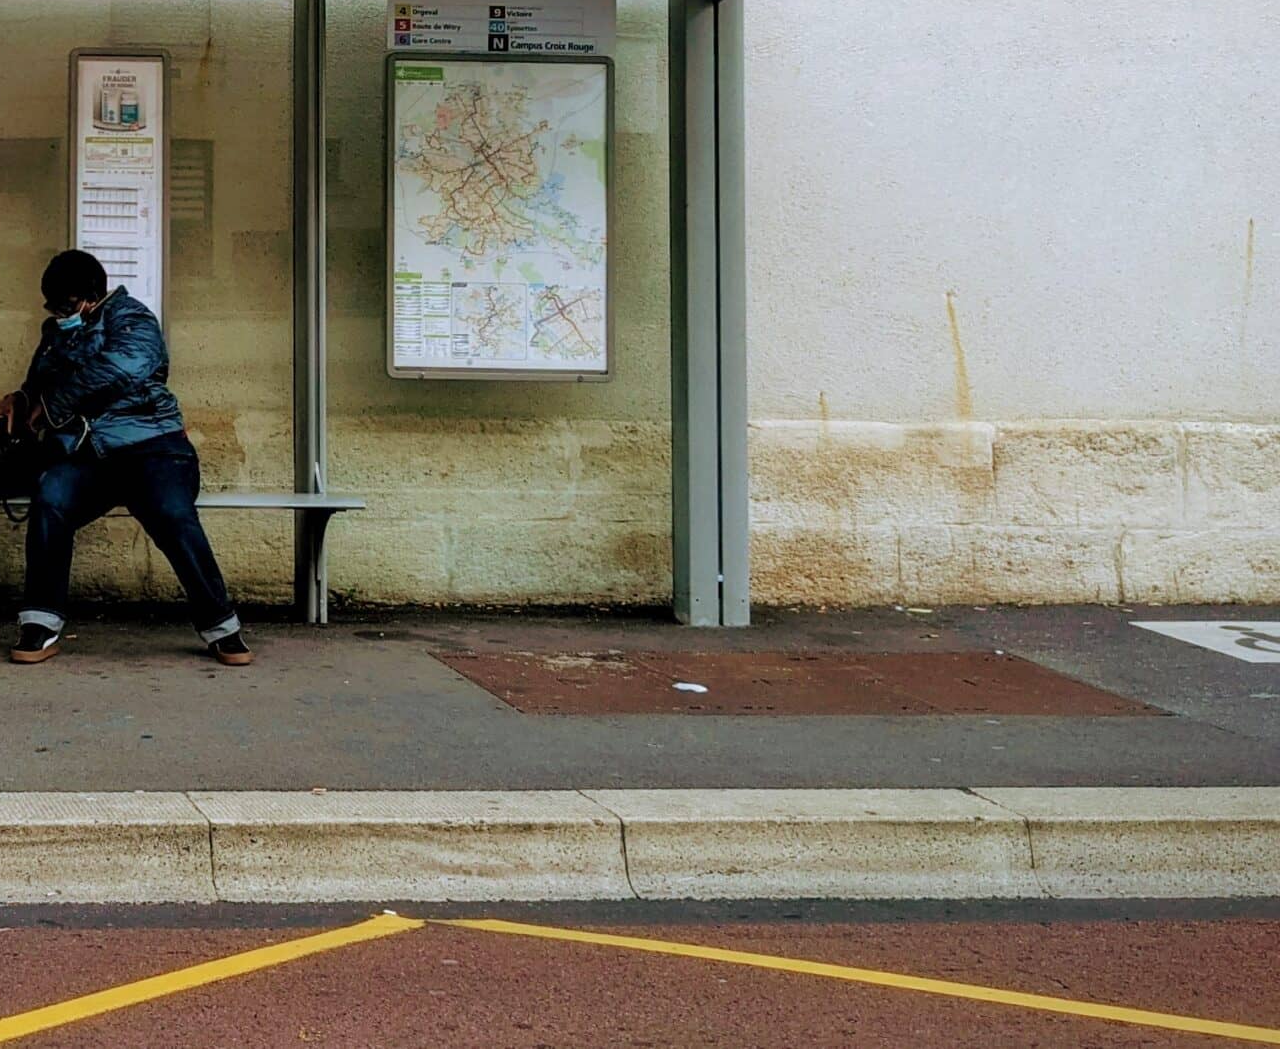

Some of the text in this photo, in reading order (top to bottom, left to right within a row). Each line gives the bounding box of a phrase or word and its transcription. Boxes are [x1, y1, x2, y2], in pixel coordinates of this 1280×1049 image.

[399, 7, 407, 16] 4
[494, 9, 501, 17] 9
[399, 22, 407, 30] 5
[489, 23, 505, 32] 40
[399, 35, 407, 44] 6
[493, 39, 594, 53] N Campus Croix Rouge
